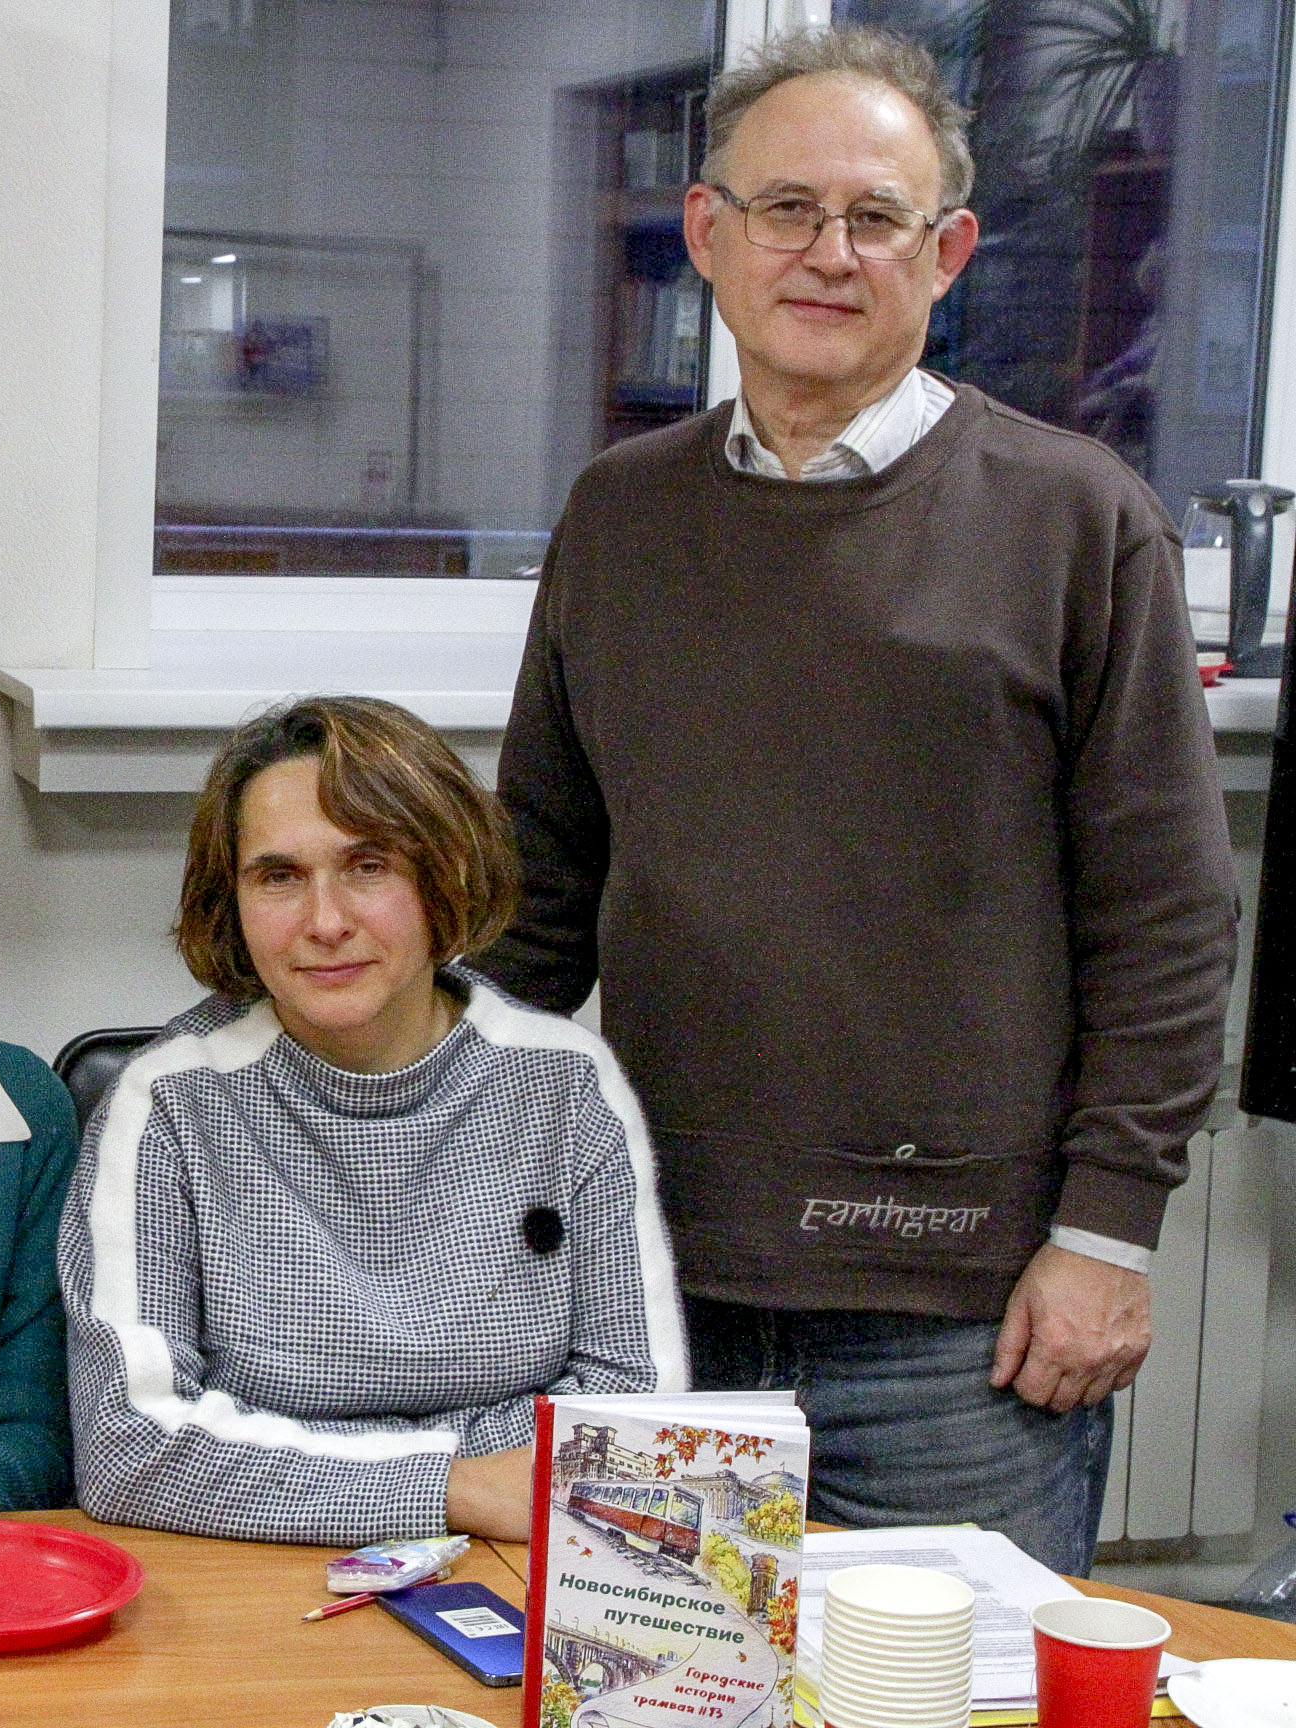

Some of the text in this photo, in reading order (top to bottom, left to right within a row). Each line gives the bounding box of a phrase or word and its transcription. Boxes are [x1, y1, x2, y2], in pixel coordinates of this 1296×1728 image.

[800, 1195, 991, 1237] Earthgear
[559, 1572, 726, 1615] Новосибирское
[604, 1608, 745, 1644] путешествие
[685, 1666, 766, 1691] Городские
[633, 1695, 694, 1715] трамвая
[674, 1684, 736, 1704] истории
